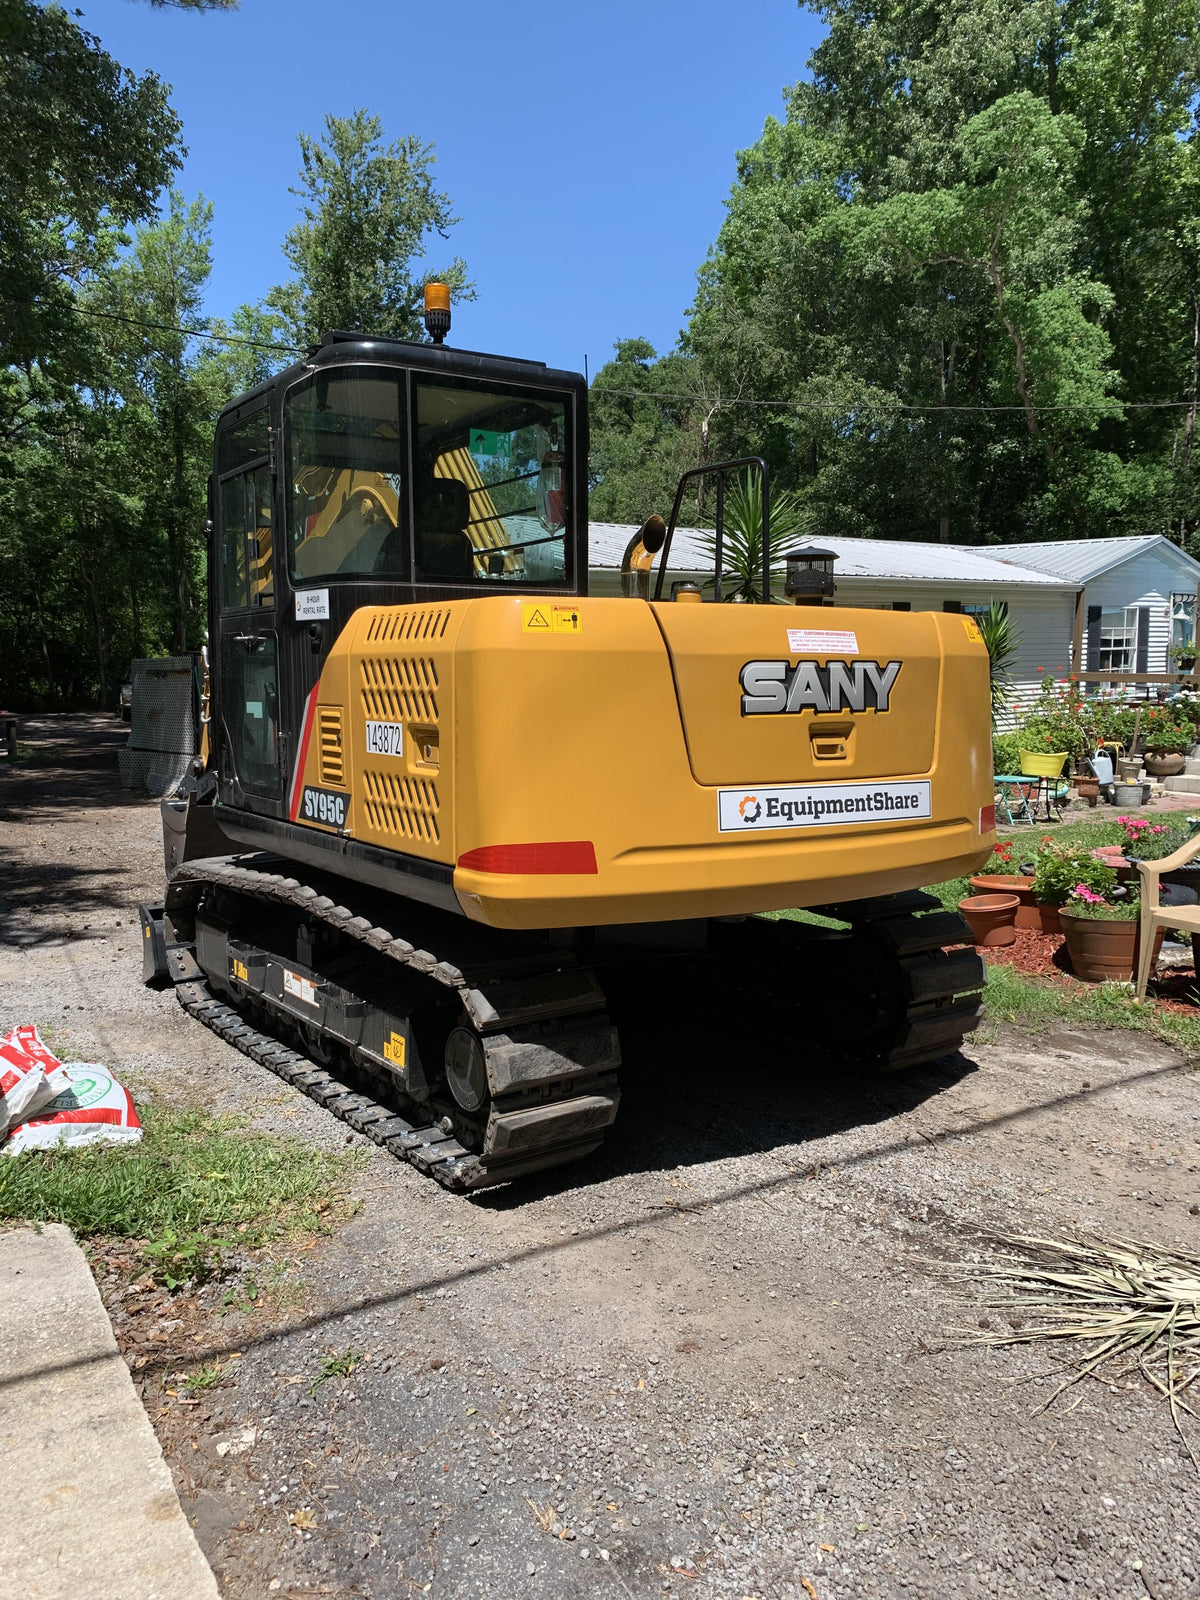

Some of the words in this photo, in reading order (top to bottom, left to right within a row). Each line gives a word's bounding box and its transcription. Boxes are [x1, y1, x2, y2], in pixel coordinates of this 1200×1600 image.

[739, 660, 902, 715] SANY
[366, 723, 401, 755] 143872
[304, 789, 344, 825] SY95C
[766, 792, 919, 821] EquipmentShare
